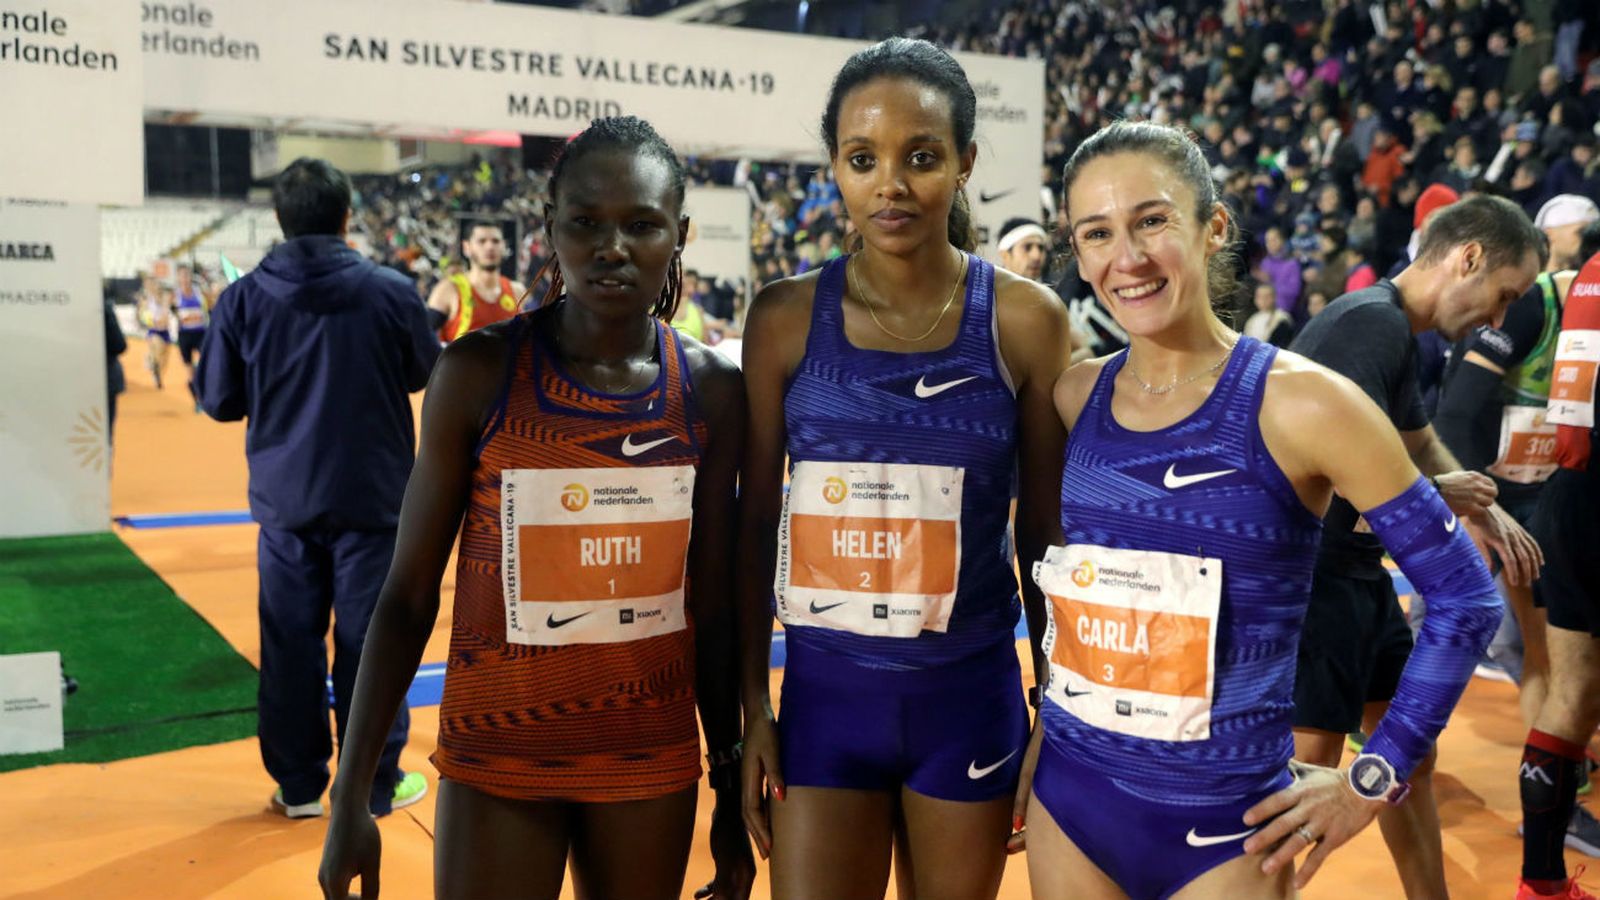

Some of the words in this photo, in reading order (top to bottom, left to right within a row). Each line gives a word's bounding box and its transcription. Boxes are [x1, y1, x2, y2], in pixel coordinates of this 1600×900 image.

[324, 33, 389, 62] SAN
[402, 40, 563, 78] SILVESTRE
[508, 94, 623, 121] MADRID
[594, 486, 639, 496] nationale
[851, 481, 895, 491] nationale
[593, 495, 654, 506] nederlanden
[851, 490, 910, 501] nederlanden
[580, 536, 641, 567] RUTH
[832, 529, 903, 560] HELEN
[778, 543, 788, 592] SILVESTRE
[1098, 566, 1145, 579] nationale
[507, 558, 517, 607] SILVESTRE
[608, 578, 615, 594] 1
[859, 571, 871, 588] 2
[1098, 576, 1161, 593] nederlanden
[1076, 614, 1150, 655] CARLA
[1102, 664, 1114, 682] 3
